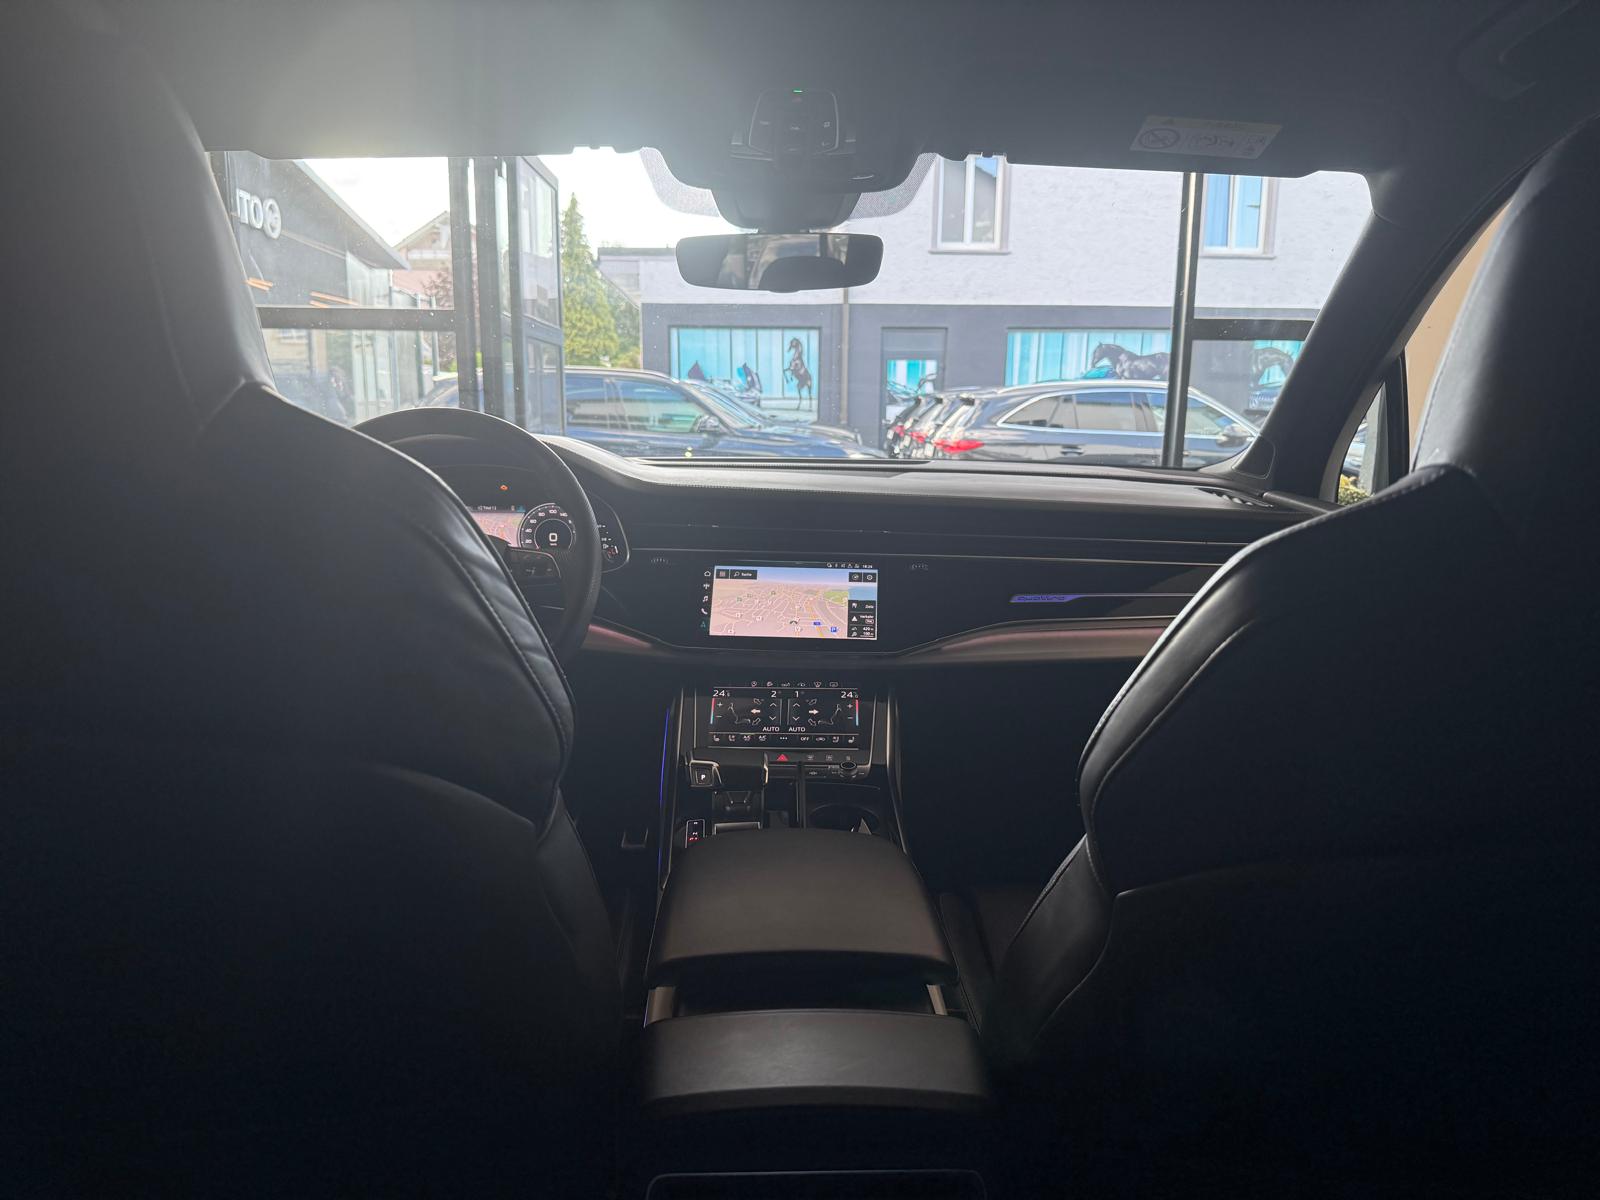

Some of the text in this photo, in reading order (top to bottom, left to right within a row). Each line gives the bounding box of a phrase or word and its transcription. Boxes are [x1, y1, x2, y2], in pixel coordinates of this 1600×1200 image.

[549, 532, 558, 542] 0
[771, 690, 777, 698] 2
[794, 690, 799, 698] 1
